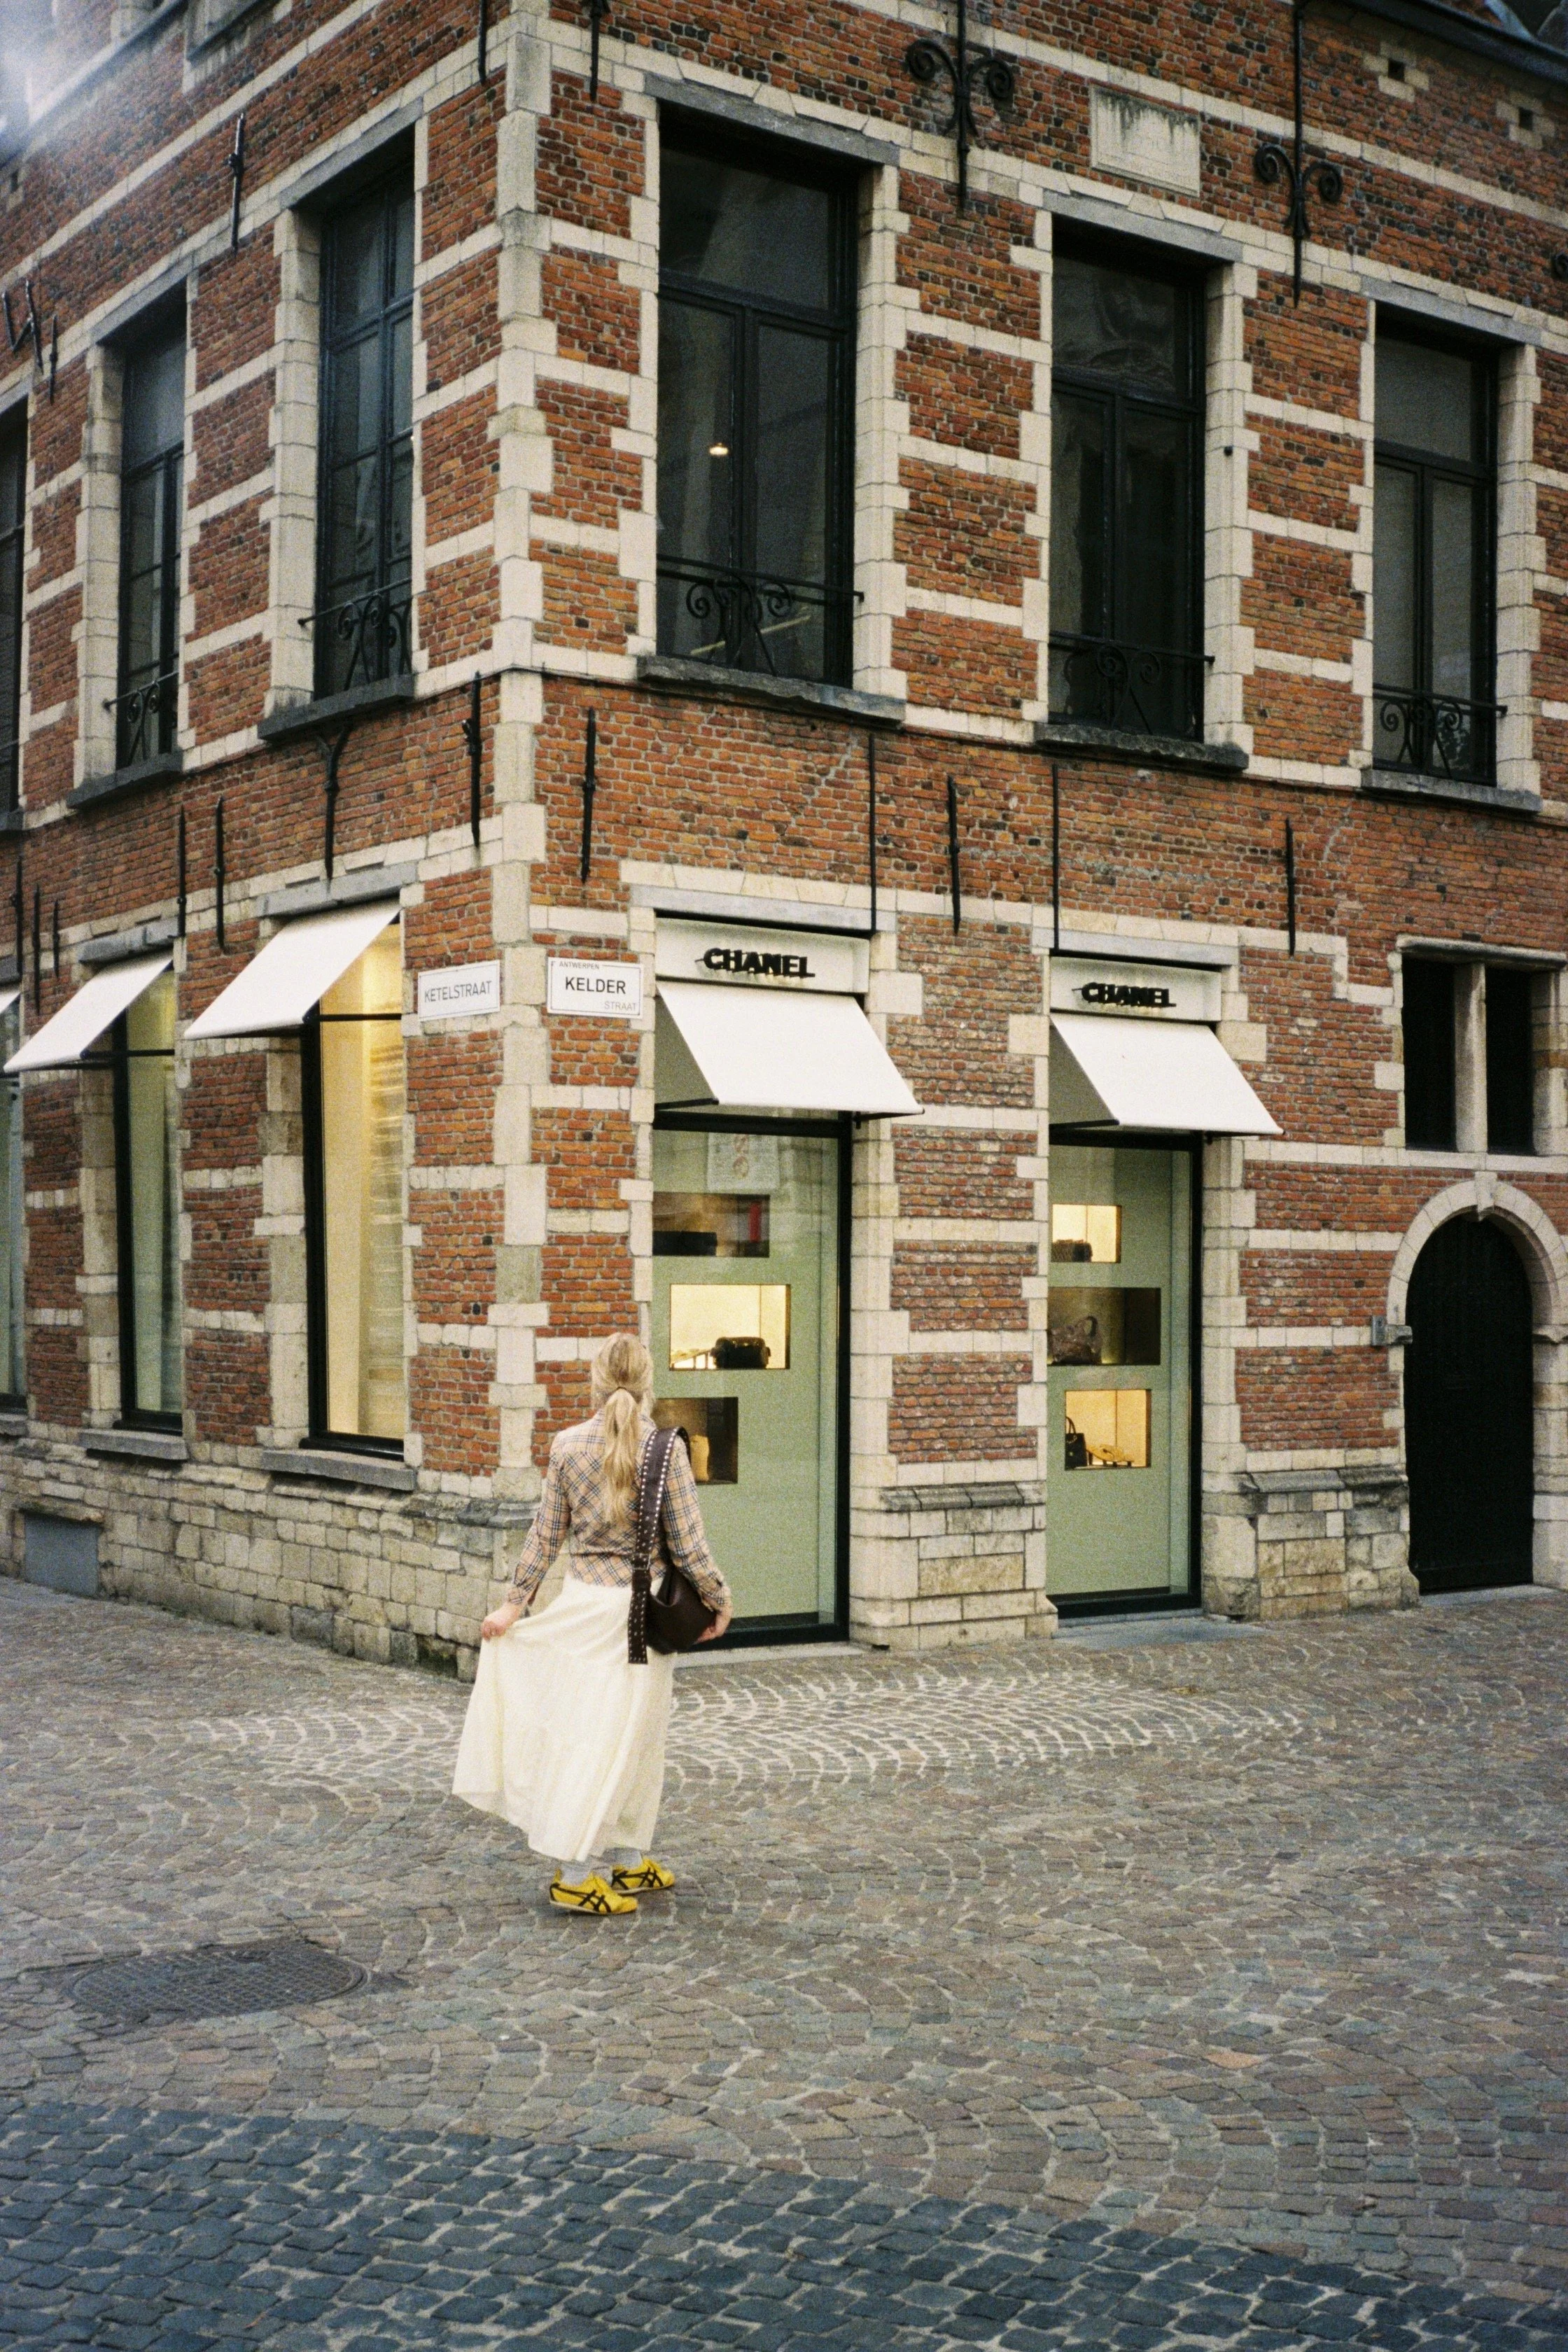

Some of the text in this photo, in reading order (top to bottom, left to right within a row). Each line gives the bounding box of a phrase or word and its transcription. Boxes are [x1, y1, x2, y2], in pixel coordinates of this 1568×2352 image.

[559, 961, 600, 970] ANTWERPEN
[703, 947, 816, 979] CHANEL
[424, 980, 492, 1003] KETELSTRAAT
[565, 976, 626, 994] KELDER
[604, 1001, 637, 1011] STRAAT
